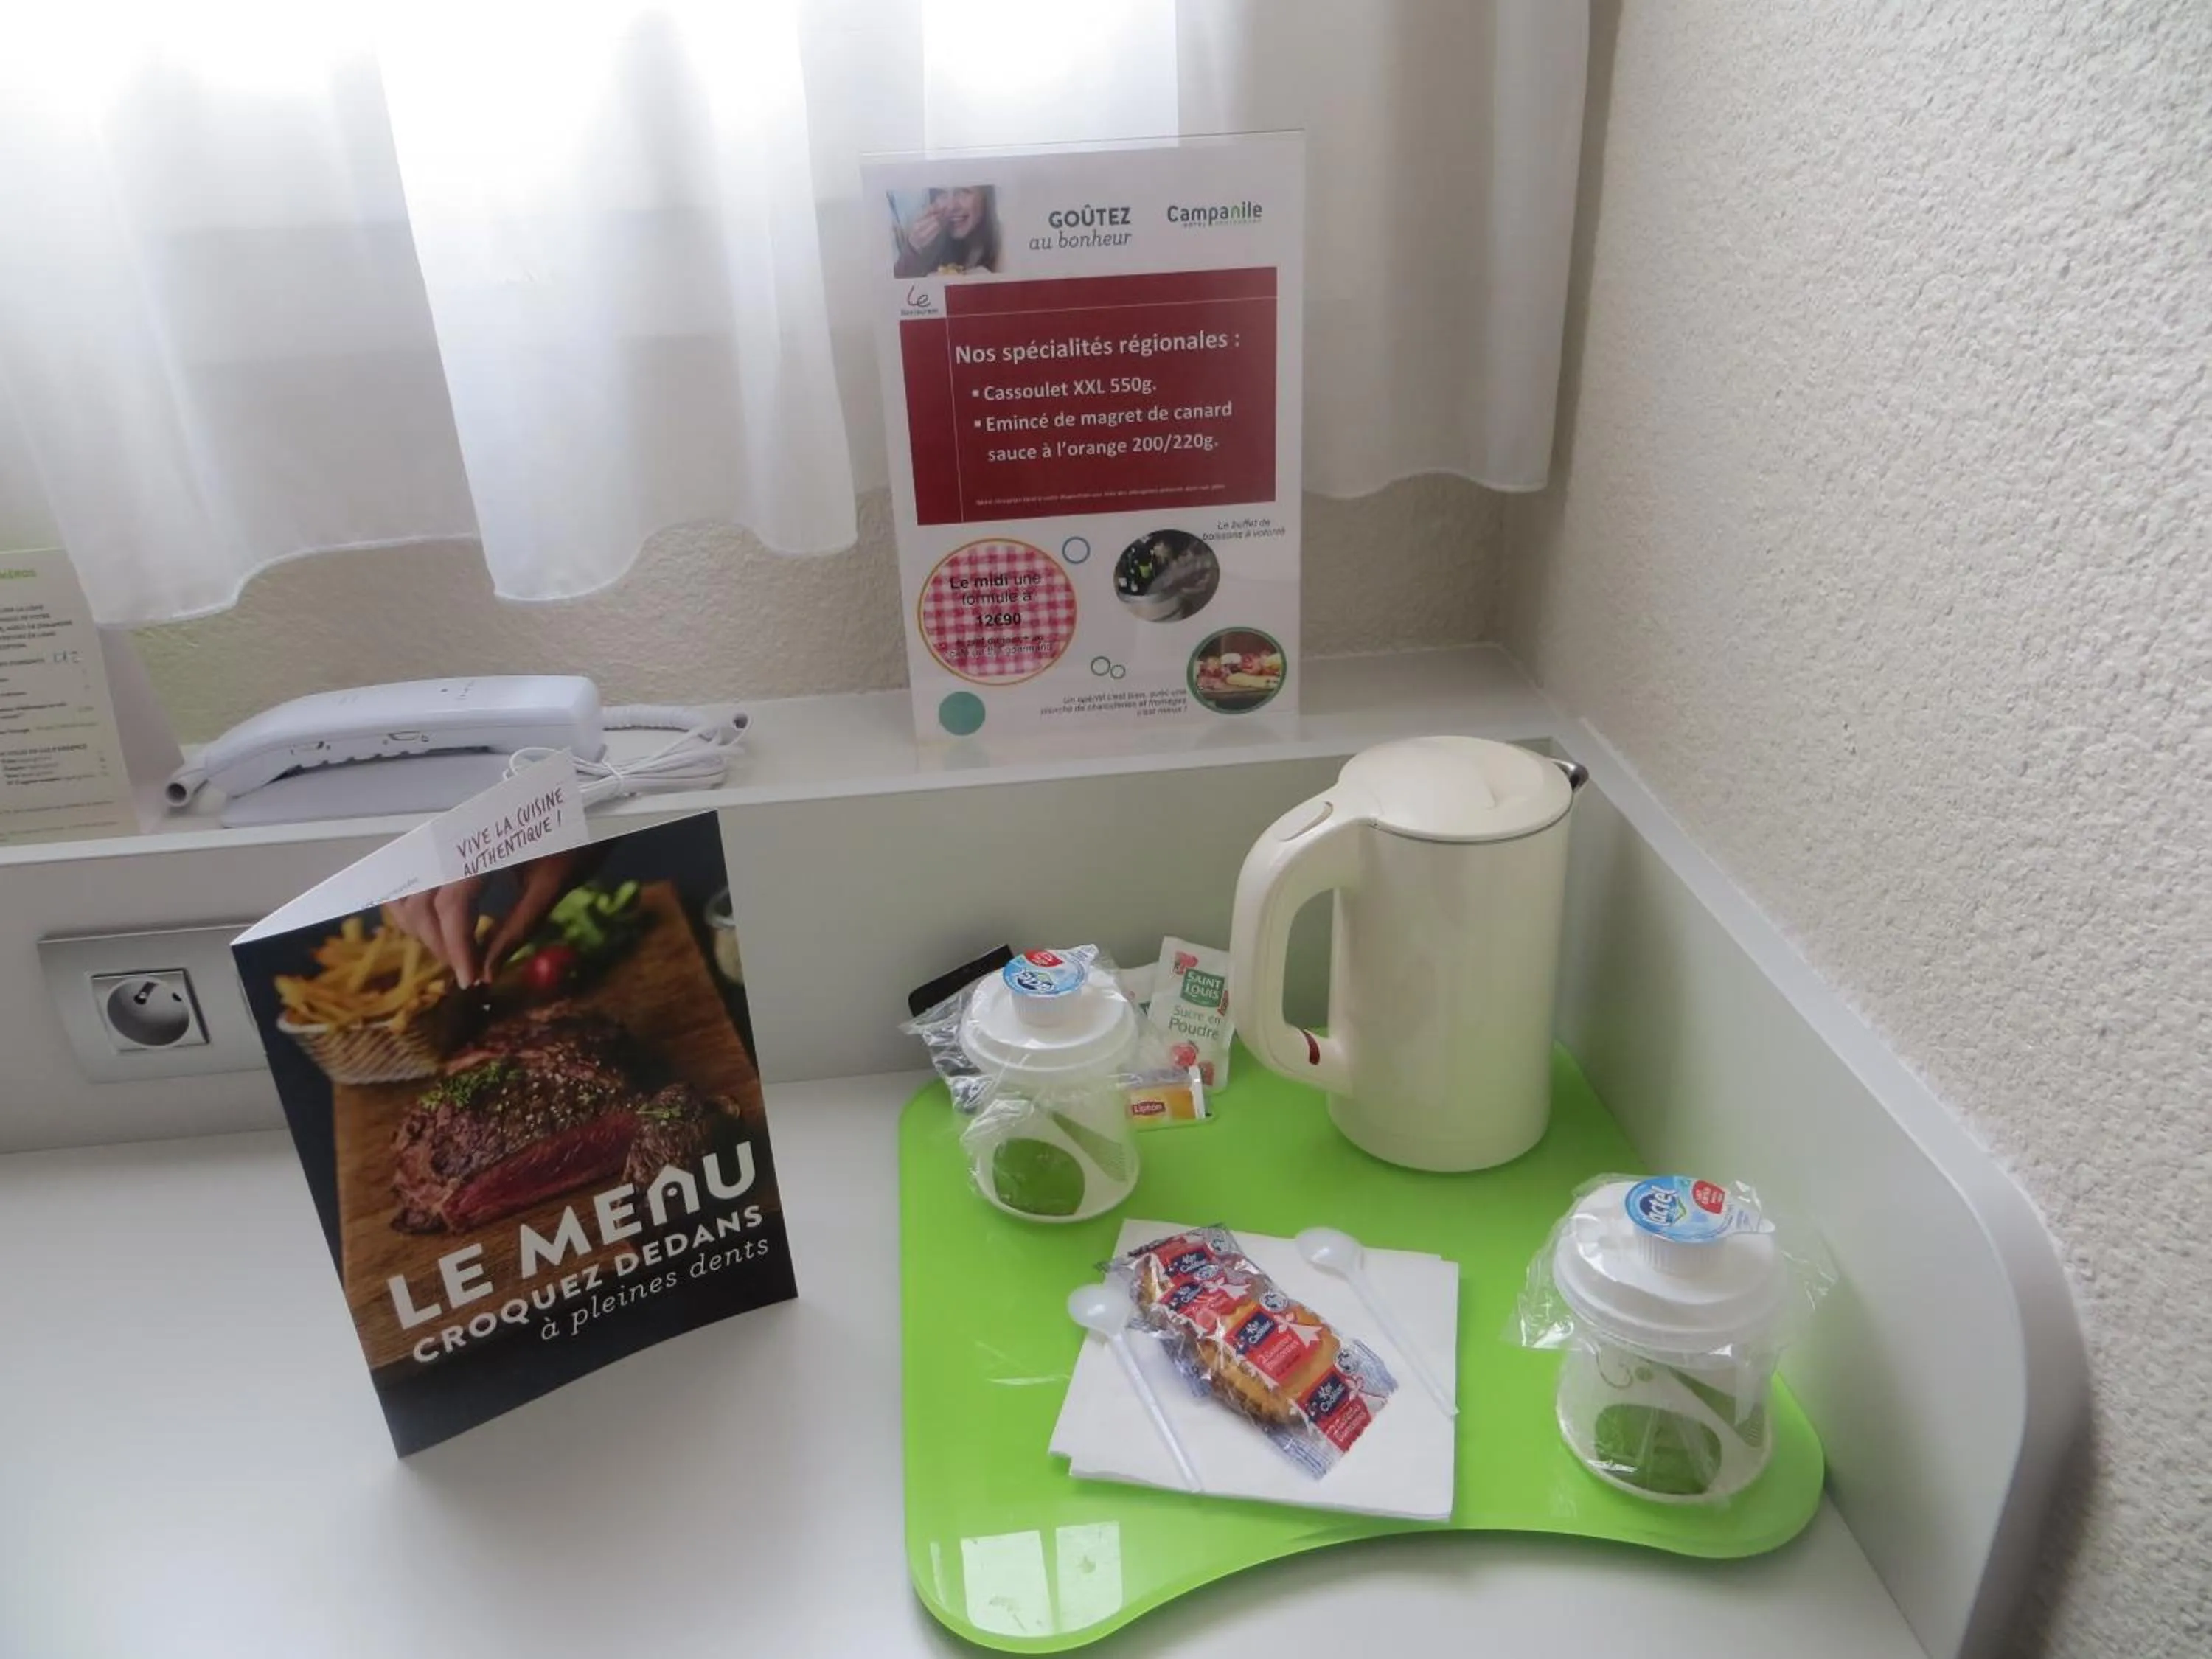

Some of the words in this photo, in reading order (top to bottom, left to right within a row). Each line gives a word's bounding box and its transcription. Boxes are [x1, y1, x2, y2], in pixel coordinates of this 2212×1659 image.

[1048, 204, 1131, 229] GOÛTEZ
[1167, 201, 1263, 226] Campanile
[1029, 237, 1052, 250] au
[1058, 229, 1132, 248] bonheur
[956, 344, 996, 364] Nos
[1002, 336, 1113, 364] spécialités
[1119, 330, 1228, 358] régionales
[1234, 333, 1240, 347] :
[984, 381, 1068, 402] Cassoulet
[1073, 379, 1105, 395] XXL
[1110, 377, 1157, 397] 550g.
[985, 413, 1048, 432] Emincé
[1053, 411, 1075, 428] de
[1080, 408, 1142, 428] magret
[1147, 405, 1169, 422] de
[1174, 402, 1233, 420] canard
[987, 445, 1037, 462] sauce
[1042, 441, 1052, 459] à
[1133, 434, 1219, 453] 200/220g.
[950, 577, 969, 590] Le
[974, 573, 1009, 588] midi
[1015, 574, 1041, 585] une
[961, 591, 1017, 605] formule
[977, 613, 1021, 627] 12€90
[456, 827, 492, 859] VIVE
[495, 816, 513, 838] LA
[517, 787, 564, 827] CUISINE
[463, 817, 552, 877] AUTHENTIQUE
[1184, 983, 1220, 999] LOUIS
[1187, 971, 1222, 989] SAINT
[1172, 1004, 1205, 1021] Sucre
[1207, 1015, 1221, 1025] en
[1168, 1016, 1220, 1040] Poudre
[387, 1243, 494, 1329] LE
[412, 1267, 603, 1364] CROQUEZ
[614, 1204, 764, 1277] DEDANS
[540, 1316, 560, 1341] à
[570, 1270, 678, 1335] pleines
[689, 1238, 770, 1279] dents
